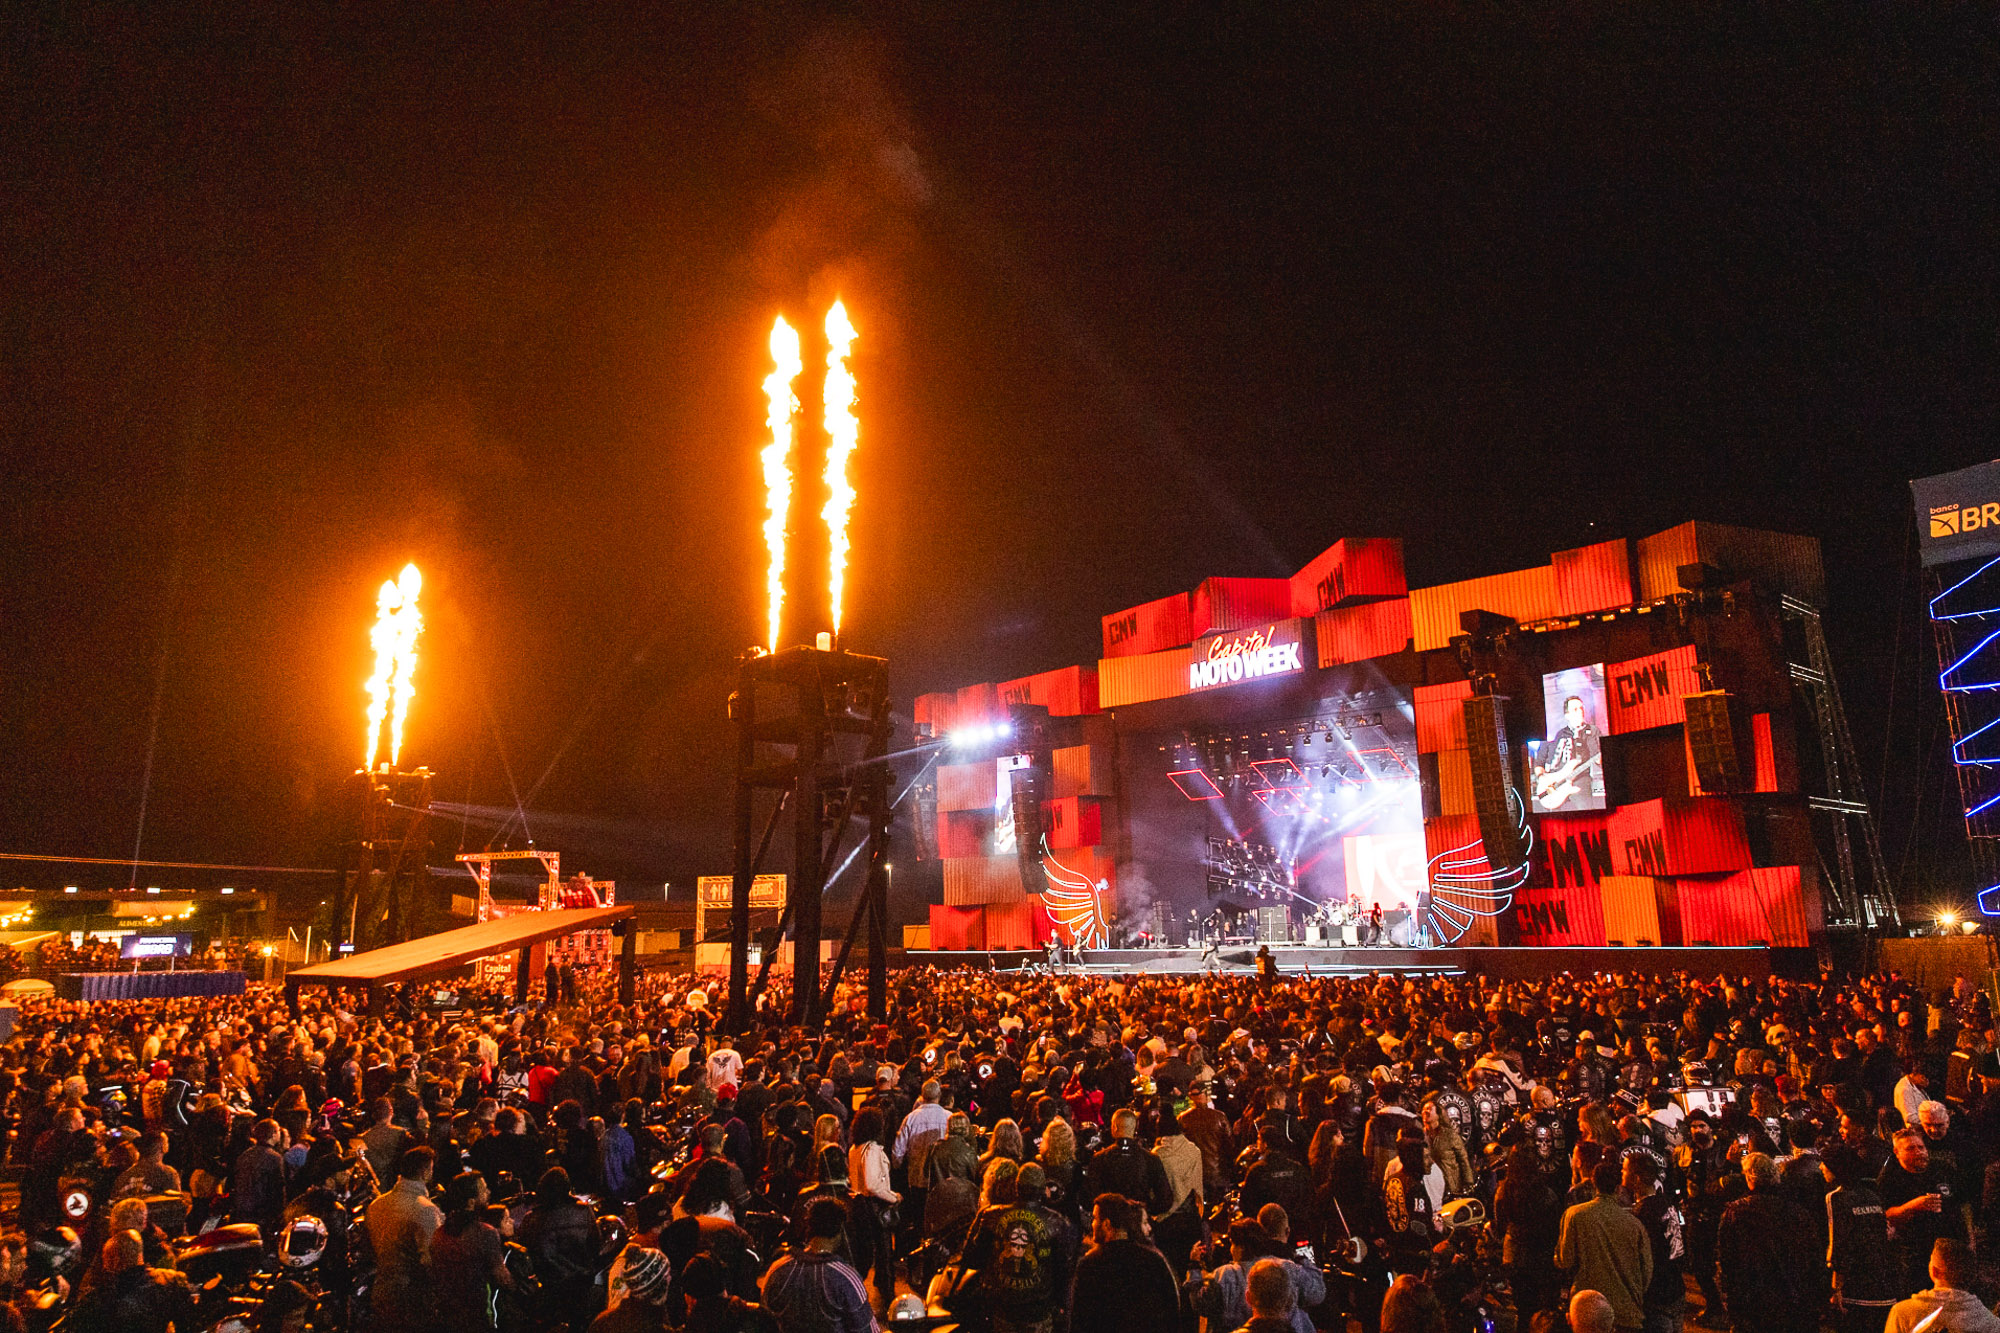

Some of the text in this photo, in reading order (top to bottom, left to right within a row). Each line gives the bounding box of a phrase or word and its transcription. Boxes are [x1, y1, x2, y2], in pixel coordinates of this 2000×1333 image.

[1930, 504, 1959, 514] banco
[1962, 502, 2000, 532] BR
[1317, 562, 1345, 612] CMW
[1109, 612, 1137, 645] CMW
[1208, 624, 1275, 662] Capital
[1616, 660, 1669, 709] CMW
[1625, 829, 1667, 876] CMW
[1516, 900, 1570, 936] CMW
[484, 963, 512, 975] Capital
[1413, 1198, 1426, 1212] 18
